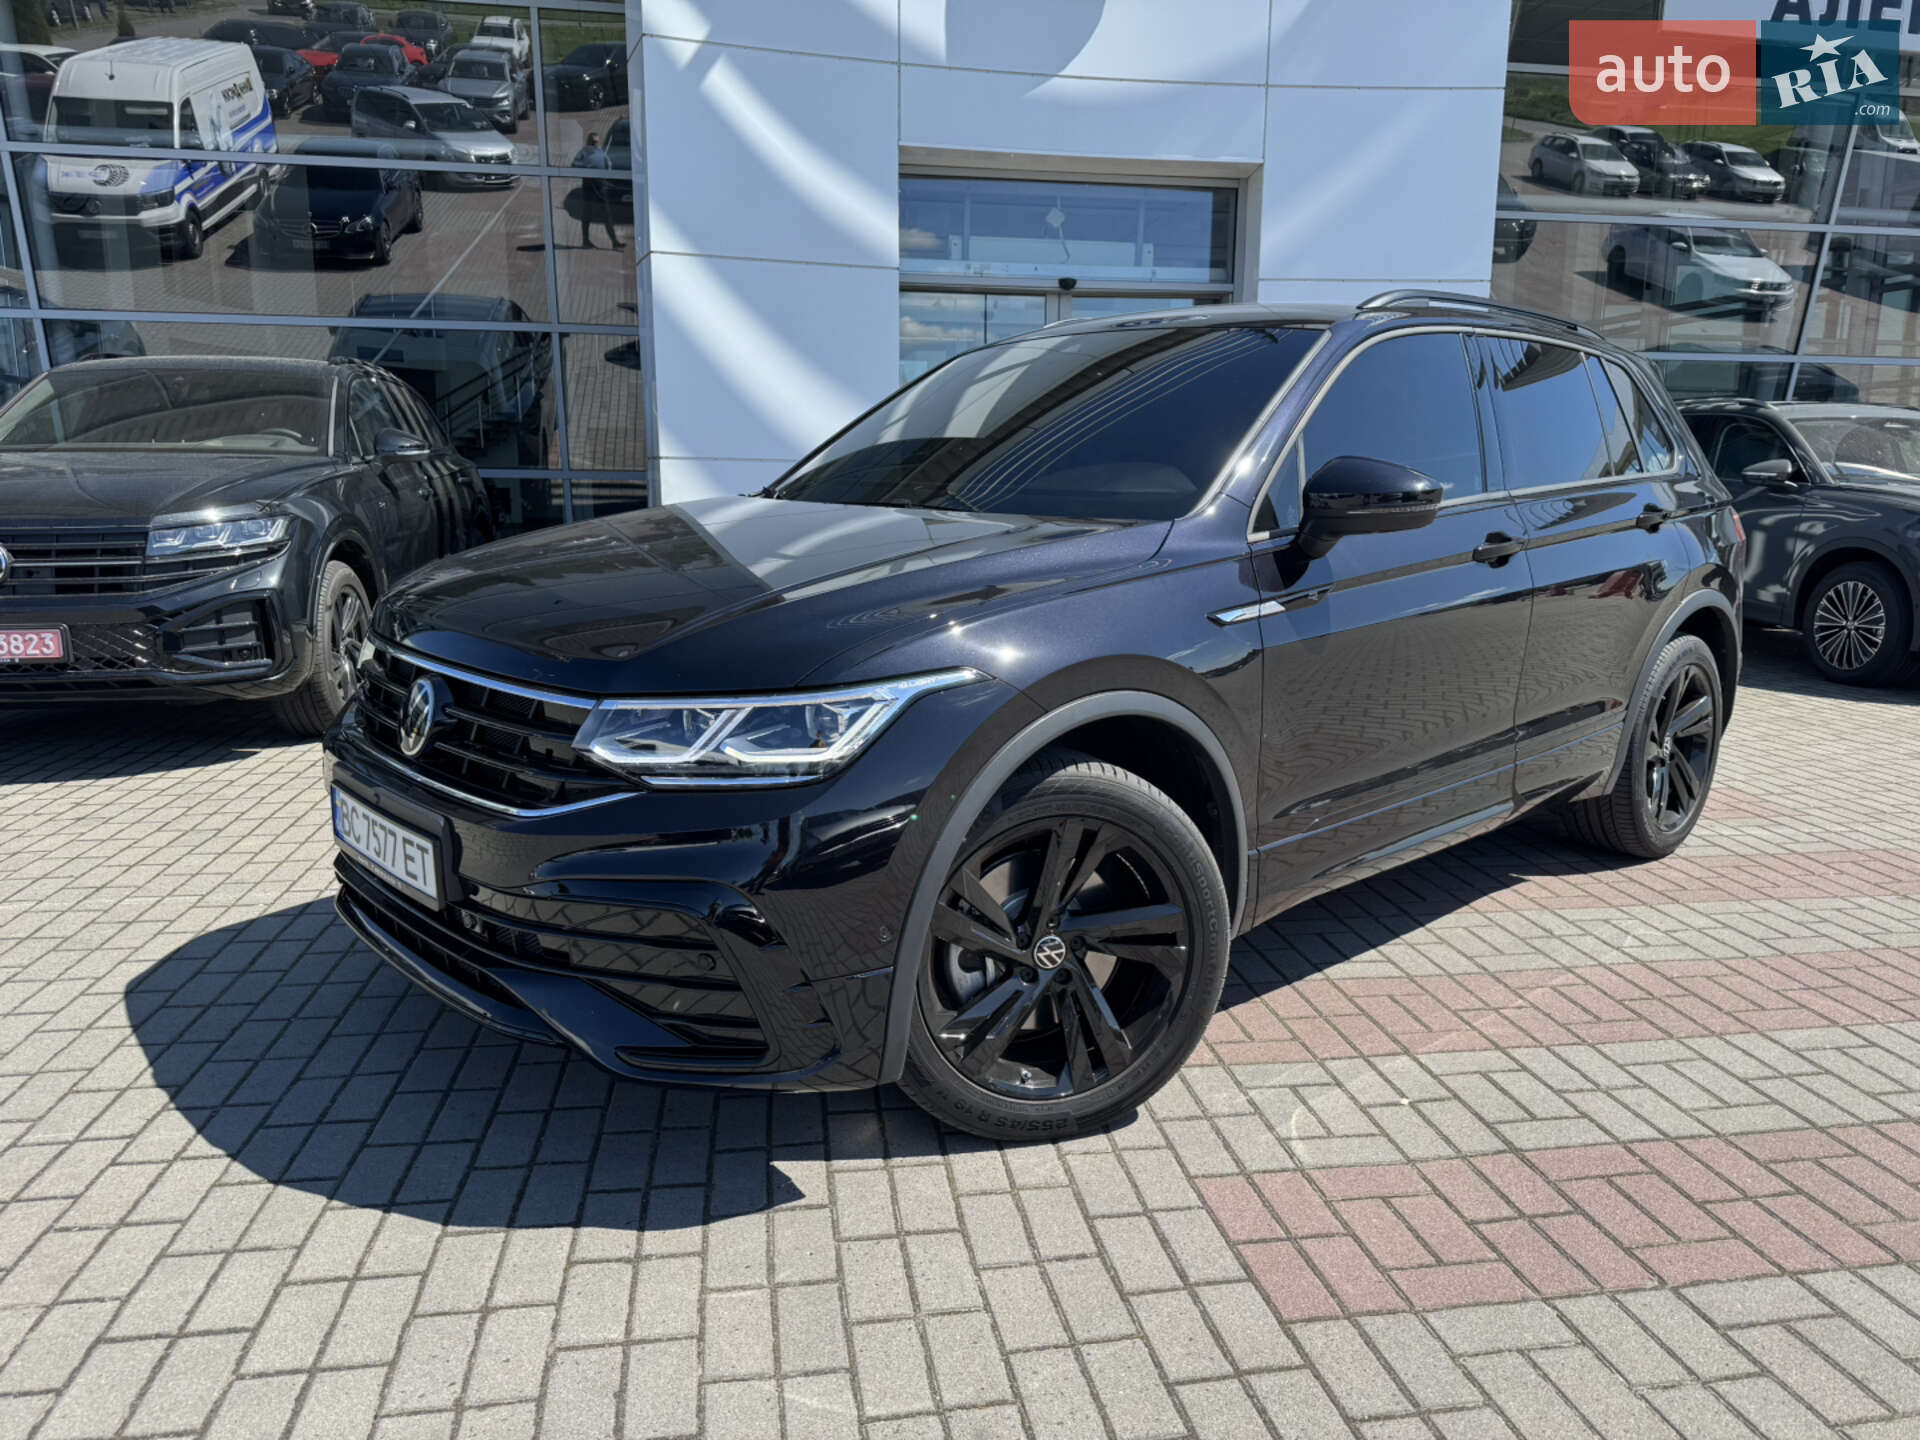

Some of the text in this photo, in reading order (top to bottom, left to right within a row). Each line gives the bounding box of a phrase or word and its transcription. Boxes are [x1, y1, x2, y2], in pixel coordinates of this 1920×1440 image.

[341, 799, 361, 844] BC
[362, 811, 397, 868] 7577
[402, 836, 430, 887] ET
